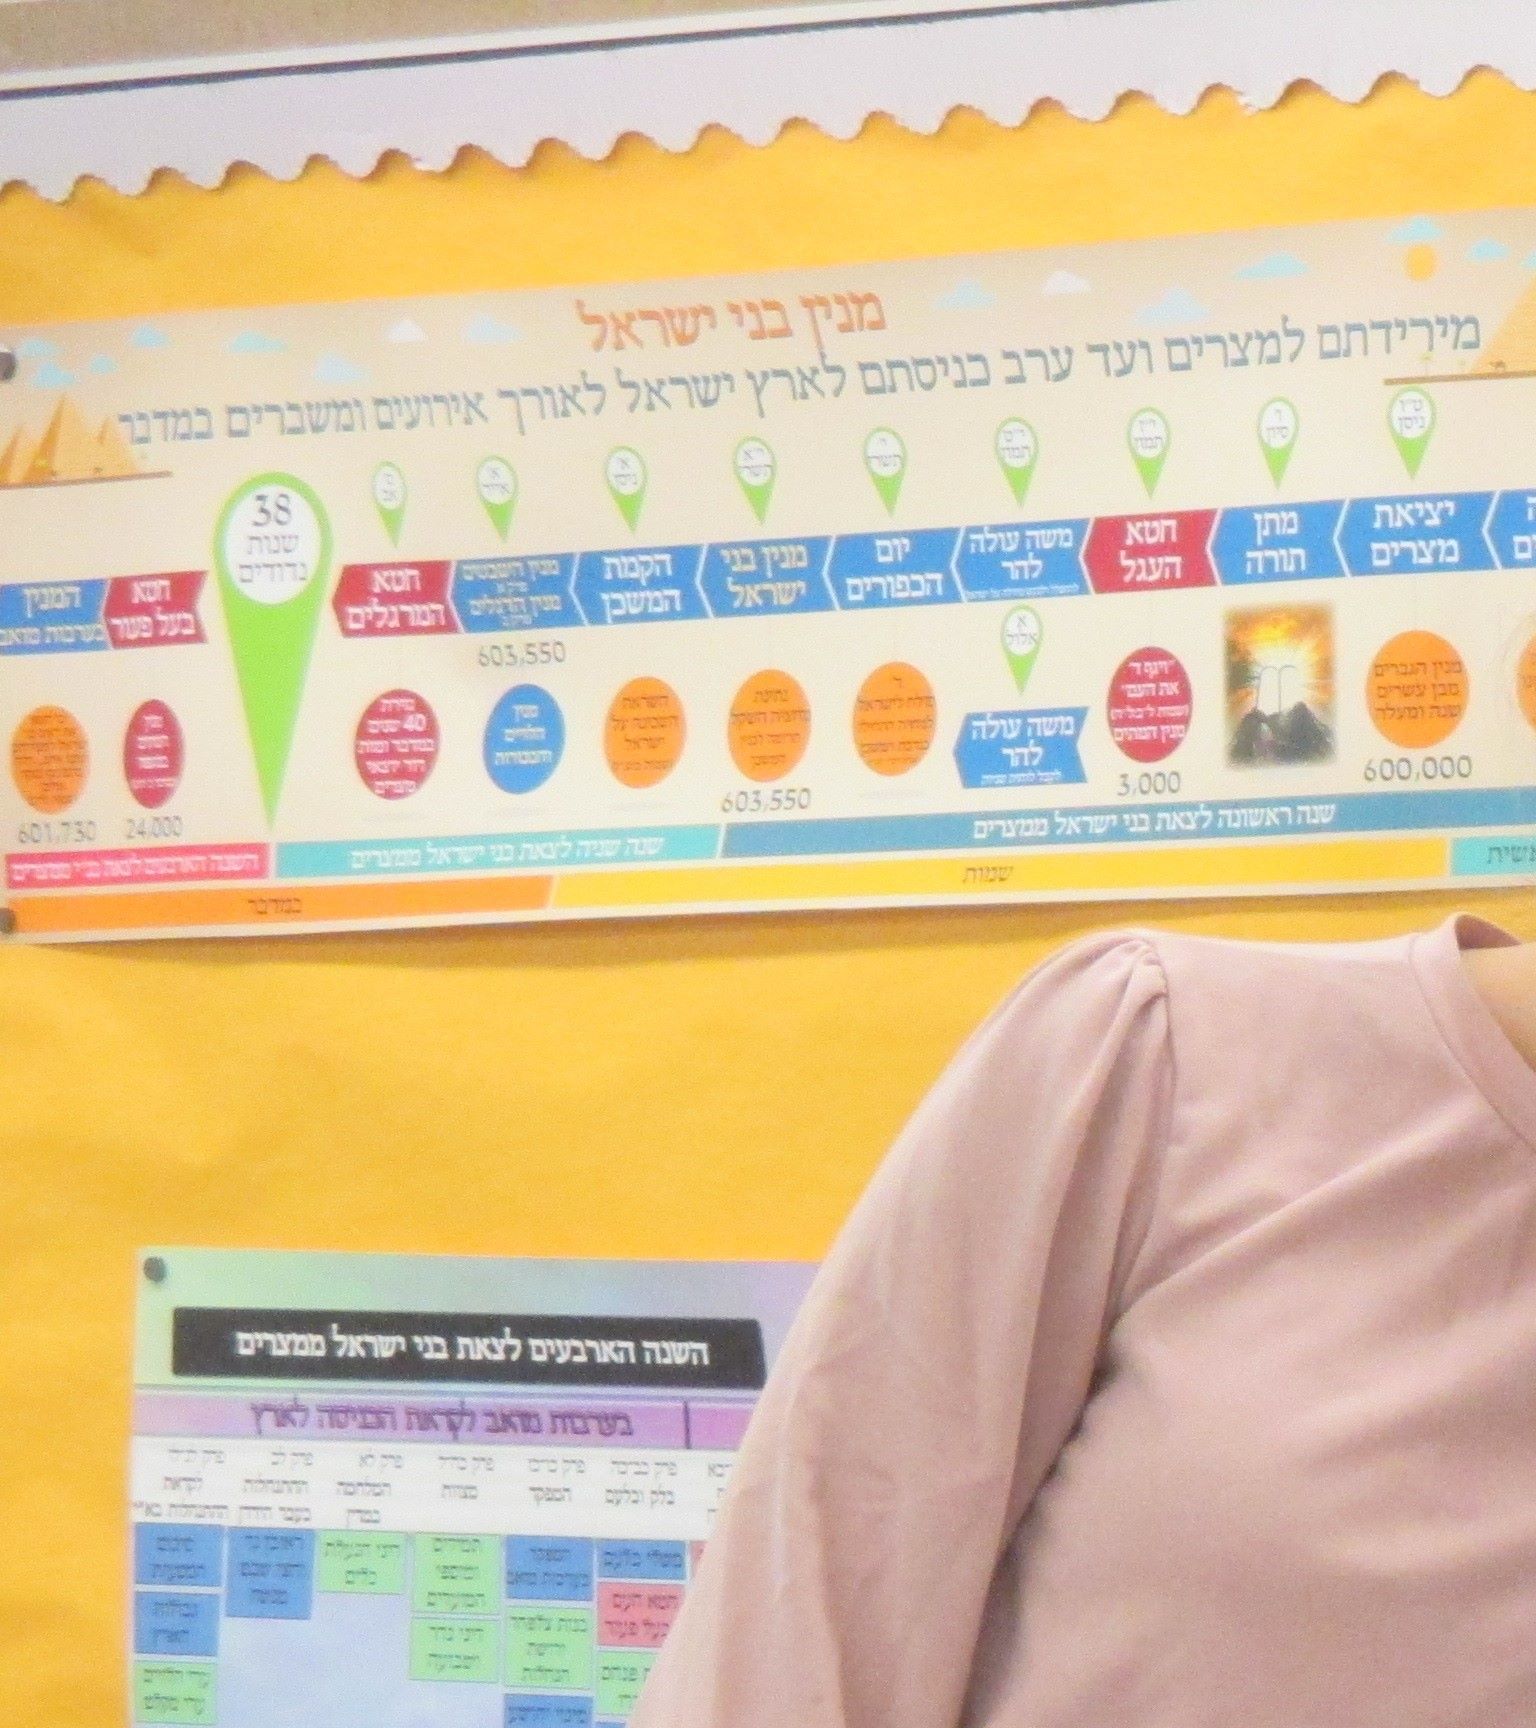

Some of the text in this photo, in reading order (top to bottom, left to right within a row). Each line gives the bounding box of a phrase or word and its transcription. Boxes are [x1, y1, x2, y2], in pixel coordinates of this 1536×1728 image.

[574, 290, 888, 358] מנין בני ישראל
[1316, 313, 1481, 360] מירידתם
[1086, 338, 1154, 378] ועד
[1164, 313, 1306, 372] למצרים
[1002, 345, 1074, 384] ערב
[497, 369, 607, 436] לאורך
[614, 366, 736, 414] ישראל
[746, 355, 847, 418] לארץ
[118, 405, 215, 445] במדבר
[225, 397, 368, 438] ומשברים
[372, 391, 489, 431] אירועים
[252, 492, 293, 528] 38
[1254, 509, 1299, 545] מתן
[1372, 498, 1457, 530] יציאת
[874, 536, 912, 564] יום
[1025, 526, 1074, 549] משה
[1124, 518, 1179, 546] חטא
[1119, 550, 1184, 583] העגל
[1245, 546, 1307, 575] תורה
[1370, 537, 1461, 567] מצרים
[1116, 770, 1181, 797] 3,000
[1363, 755, 1473, 783] 600,000
[720, 787, 813, 814] 603,550
[330, 1322, 407, 1359] ישראל
[411, 1334, 450, 1360] בני
[455, 1325, 523, 1362] לצאת
[527, 1337, 637, 1365] הארבעים
[641, 1339, 711, 1366] השנה
